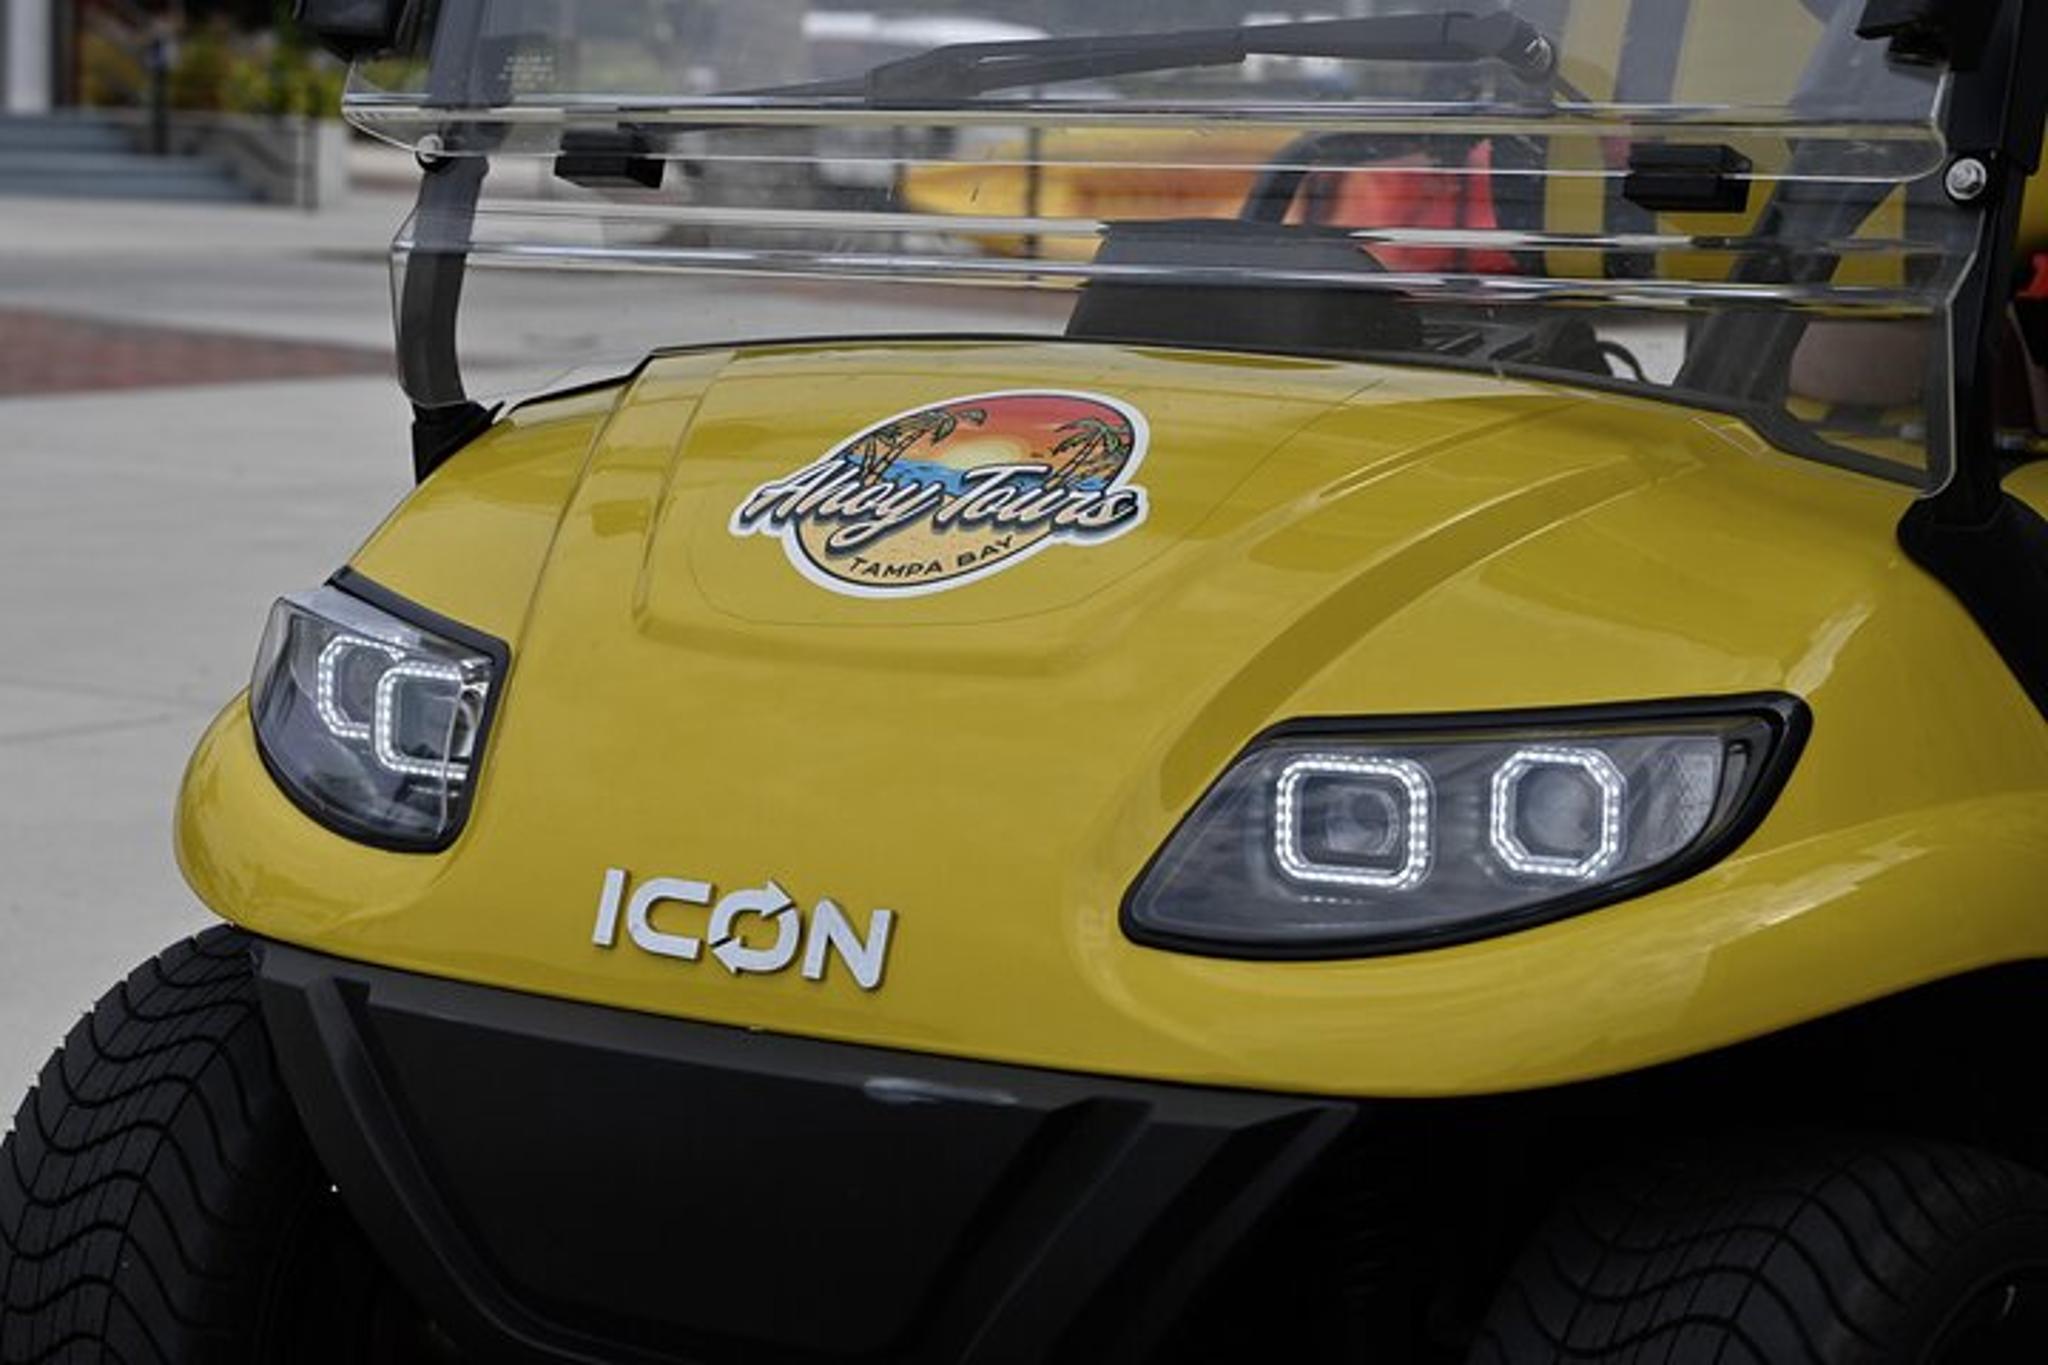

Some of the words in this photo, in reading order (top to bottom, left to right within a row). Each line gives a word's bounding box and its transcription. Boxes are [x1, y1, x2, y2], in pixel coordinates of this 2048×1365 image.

[742, 458, 944, 555] Ahoy
[932, 463, 1139, 533] Tours
[849, 556, 944, 578] TAMPA
[956, 534, 1014, 567] BAY
[592, 867, 893, 990] ICON
